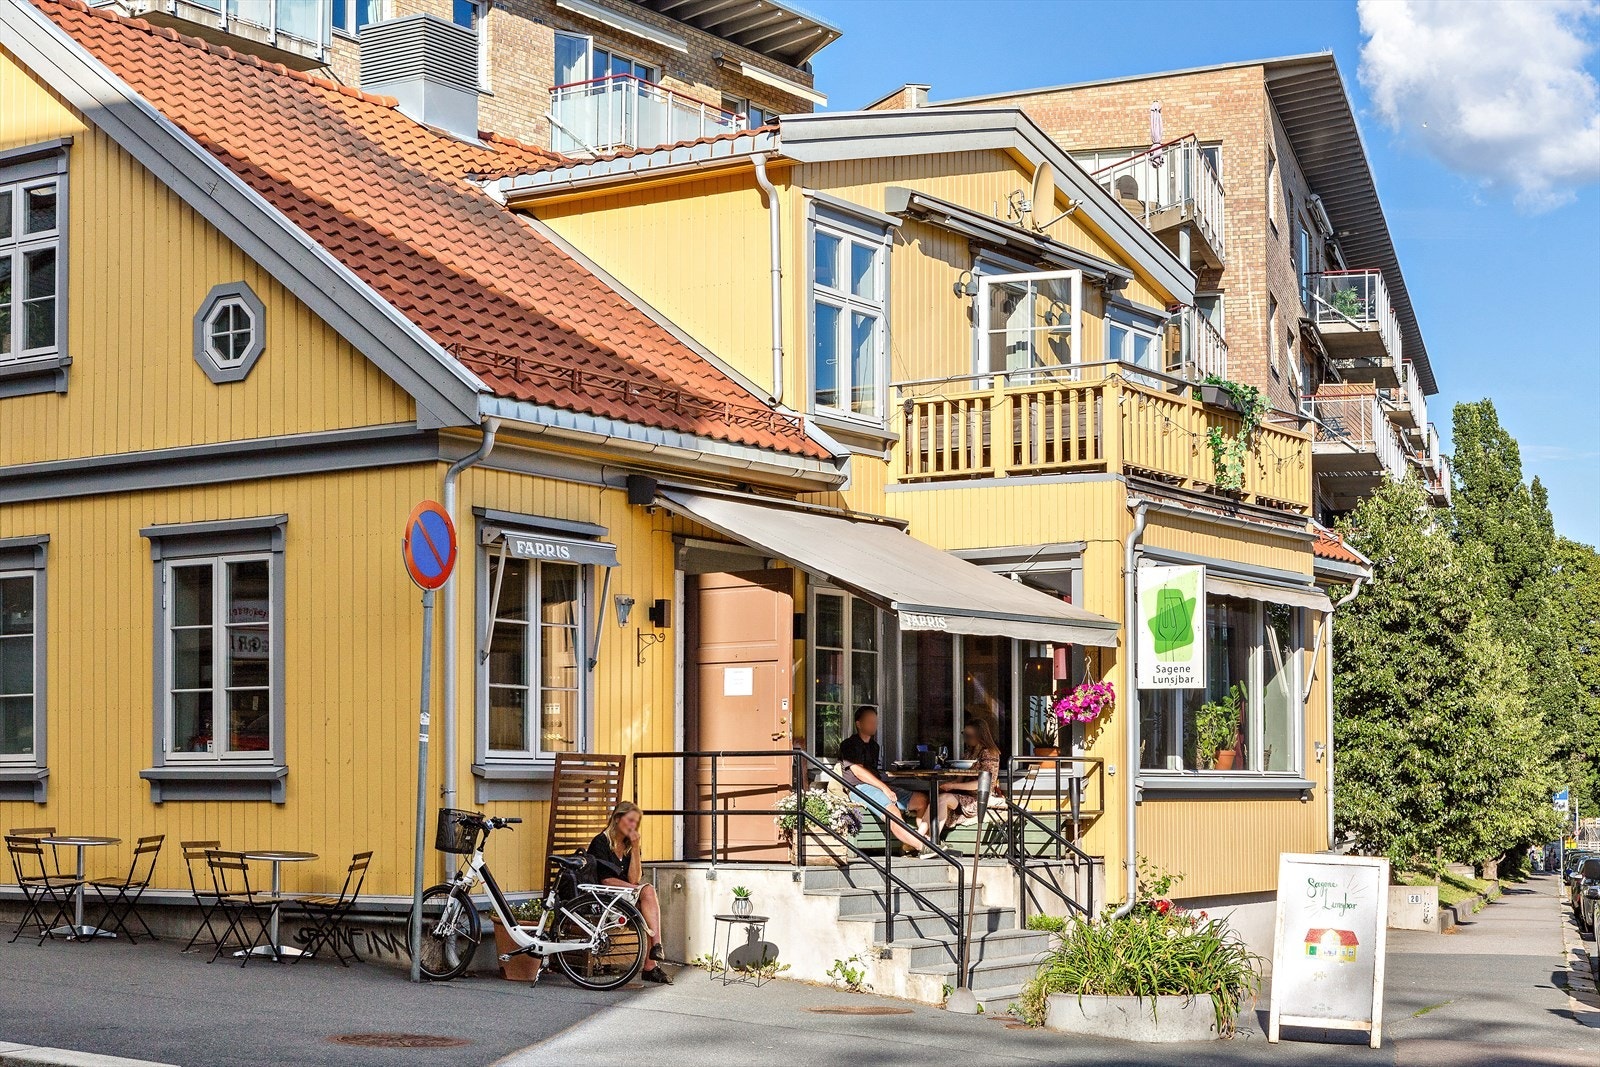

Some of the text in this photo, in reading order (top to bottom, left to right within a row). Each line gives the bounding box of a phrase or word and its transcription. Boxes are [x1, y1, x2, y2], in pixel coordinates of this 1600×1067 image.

[516, 540, 570, 559] FARRIS
[905, 614, 947, 629] FARRIS
[1156, 665, 1191, 675] Sagene
[1152, 674, 1195, 686] Lunsjbar
